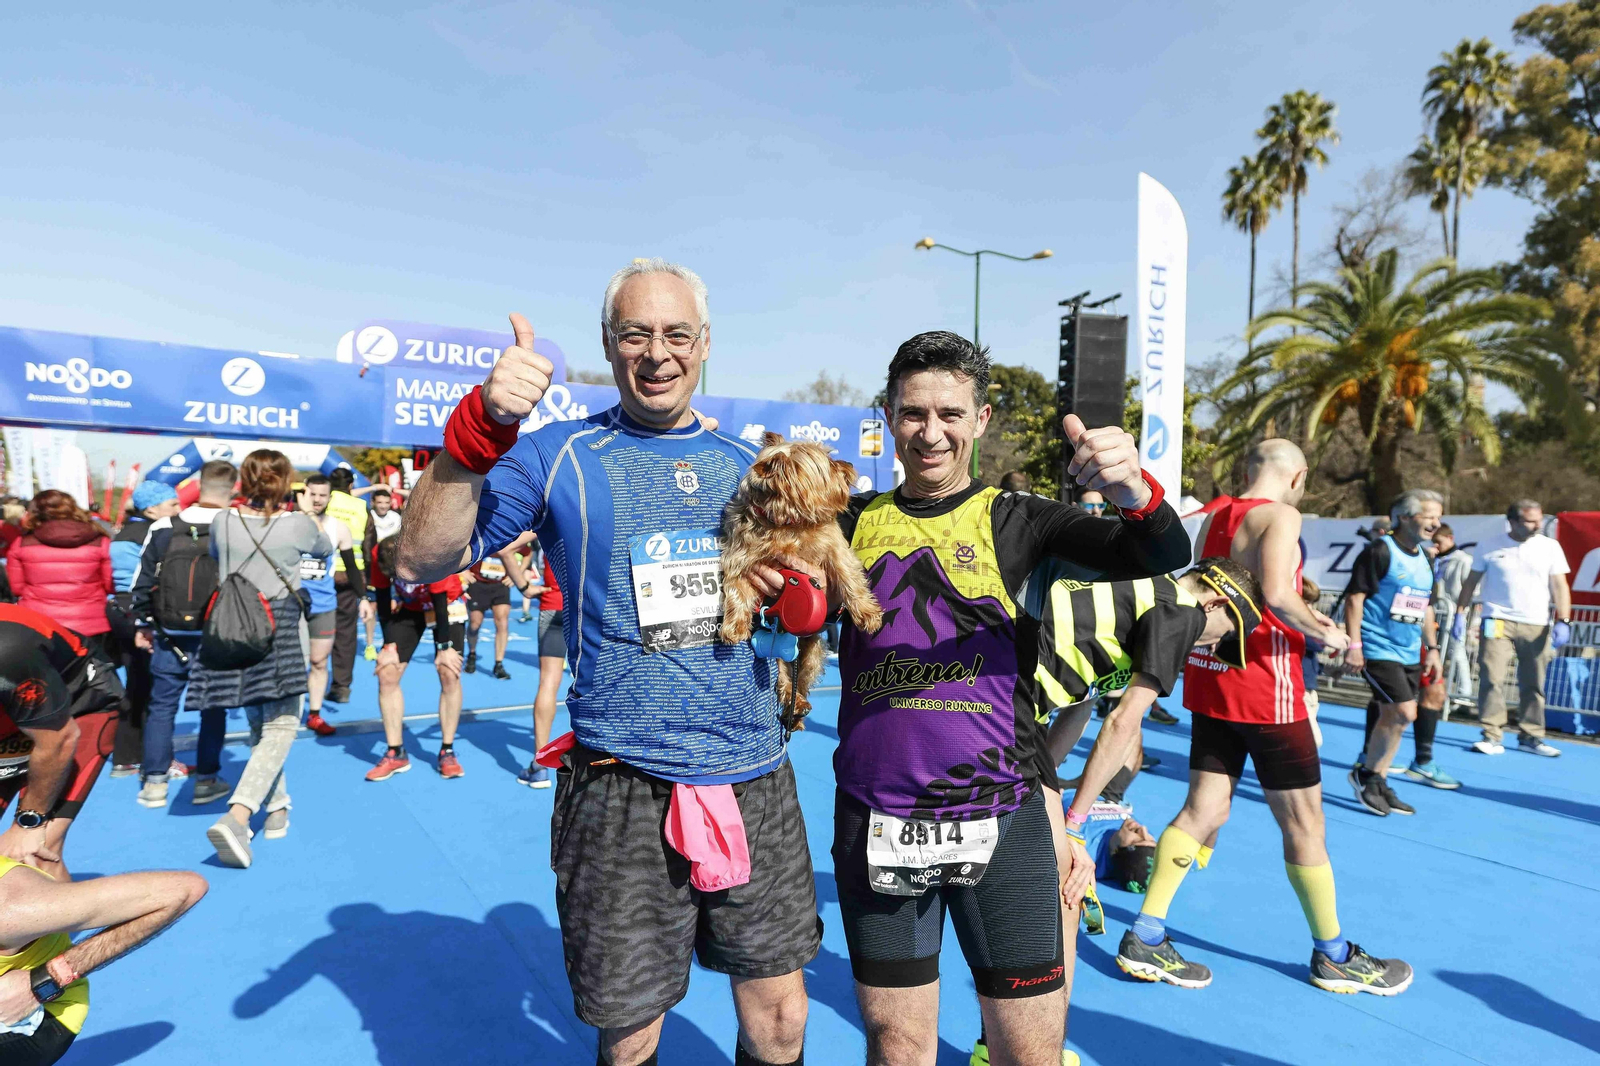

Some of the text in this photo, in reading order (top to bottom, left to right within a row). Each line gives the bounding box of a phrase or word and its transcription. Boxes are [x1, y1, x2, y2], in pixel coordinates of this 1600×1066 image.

[396, 377, 475, 402] MARAT
[183, 400, 300, 429] ZURICH
[852, 651, 984, 694] entrena!
[889, 697, 993, 714] UNIVERSO RUNNING
